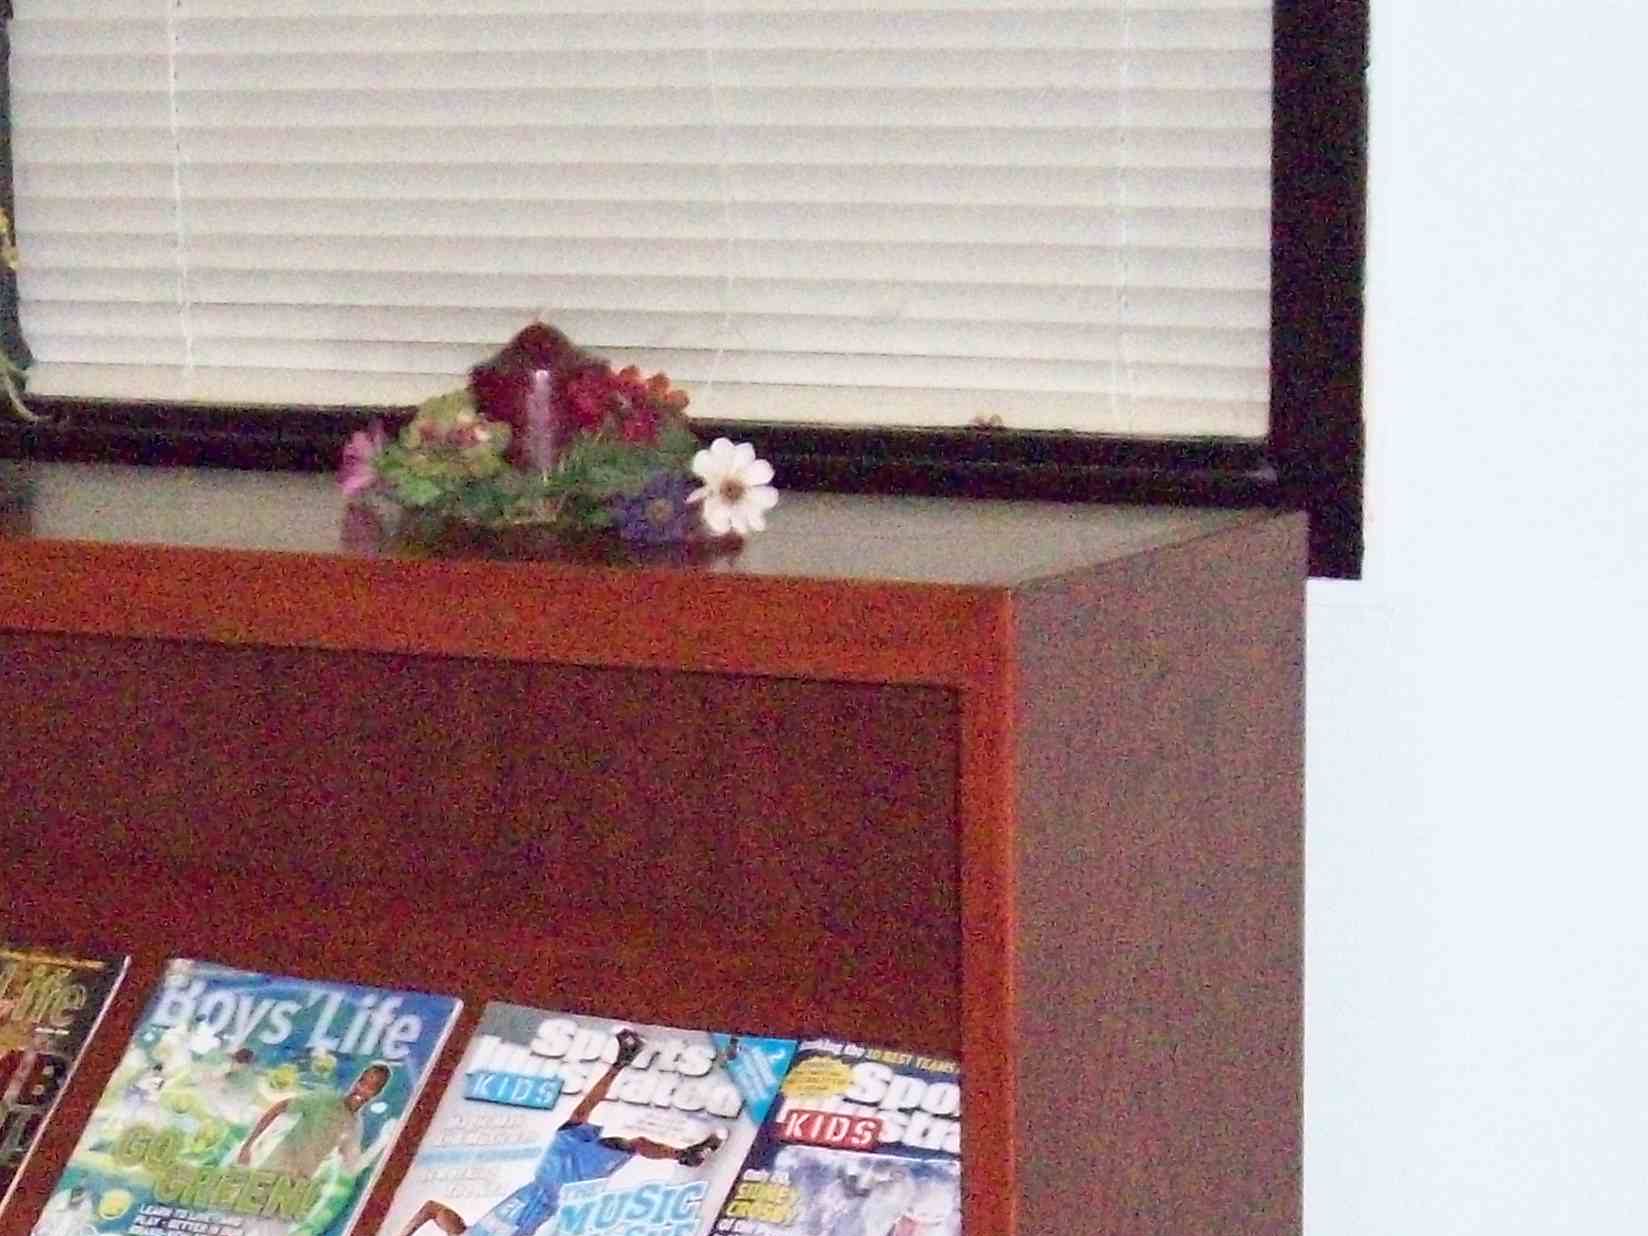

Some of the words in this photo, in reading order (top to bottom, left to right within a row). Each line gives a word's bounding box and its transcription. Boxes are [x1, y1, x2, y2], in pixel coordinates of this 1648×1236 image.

[152, 968, 314, 1062] Boys'
[304, 997, 425, 1063] Life
[469, 1076, 556, 1106] KIDS
[785, 1112, 877, 1146] KIDS
[558, 1182, 706, 1236] MUSIC
